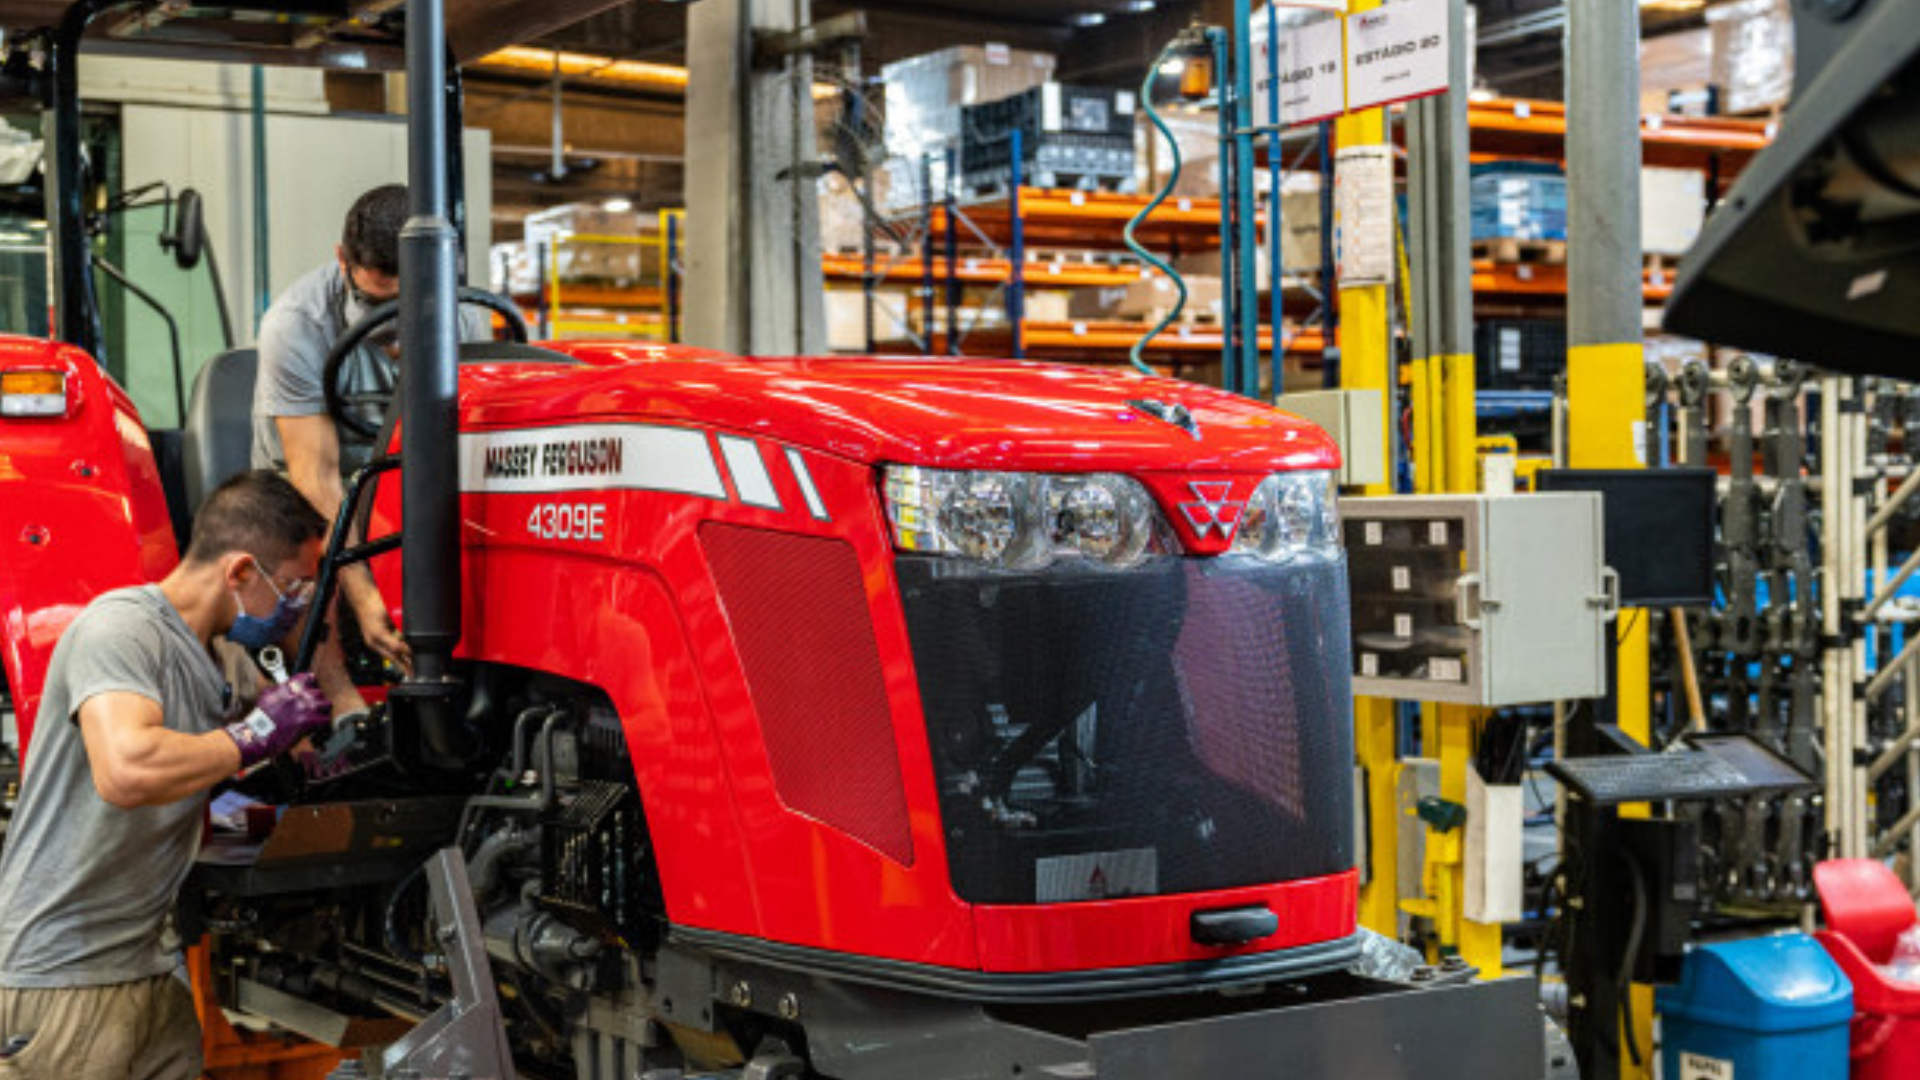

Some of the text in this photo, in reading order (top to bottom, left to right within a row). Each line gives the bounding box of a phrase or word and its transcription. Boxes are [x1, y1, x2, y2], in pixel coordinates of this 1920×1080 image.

[484, 437, 622, 478] MASSEY FERGUSON
[527, 503, 606, 540] 4309E
